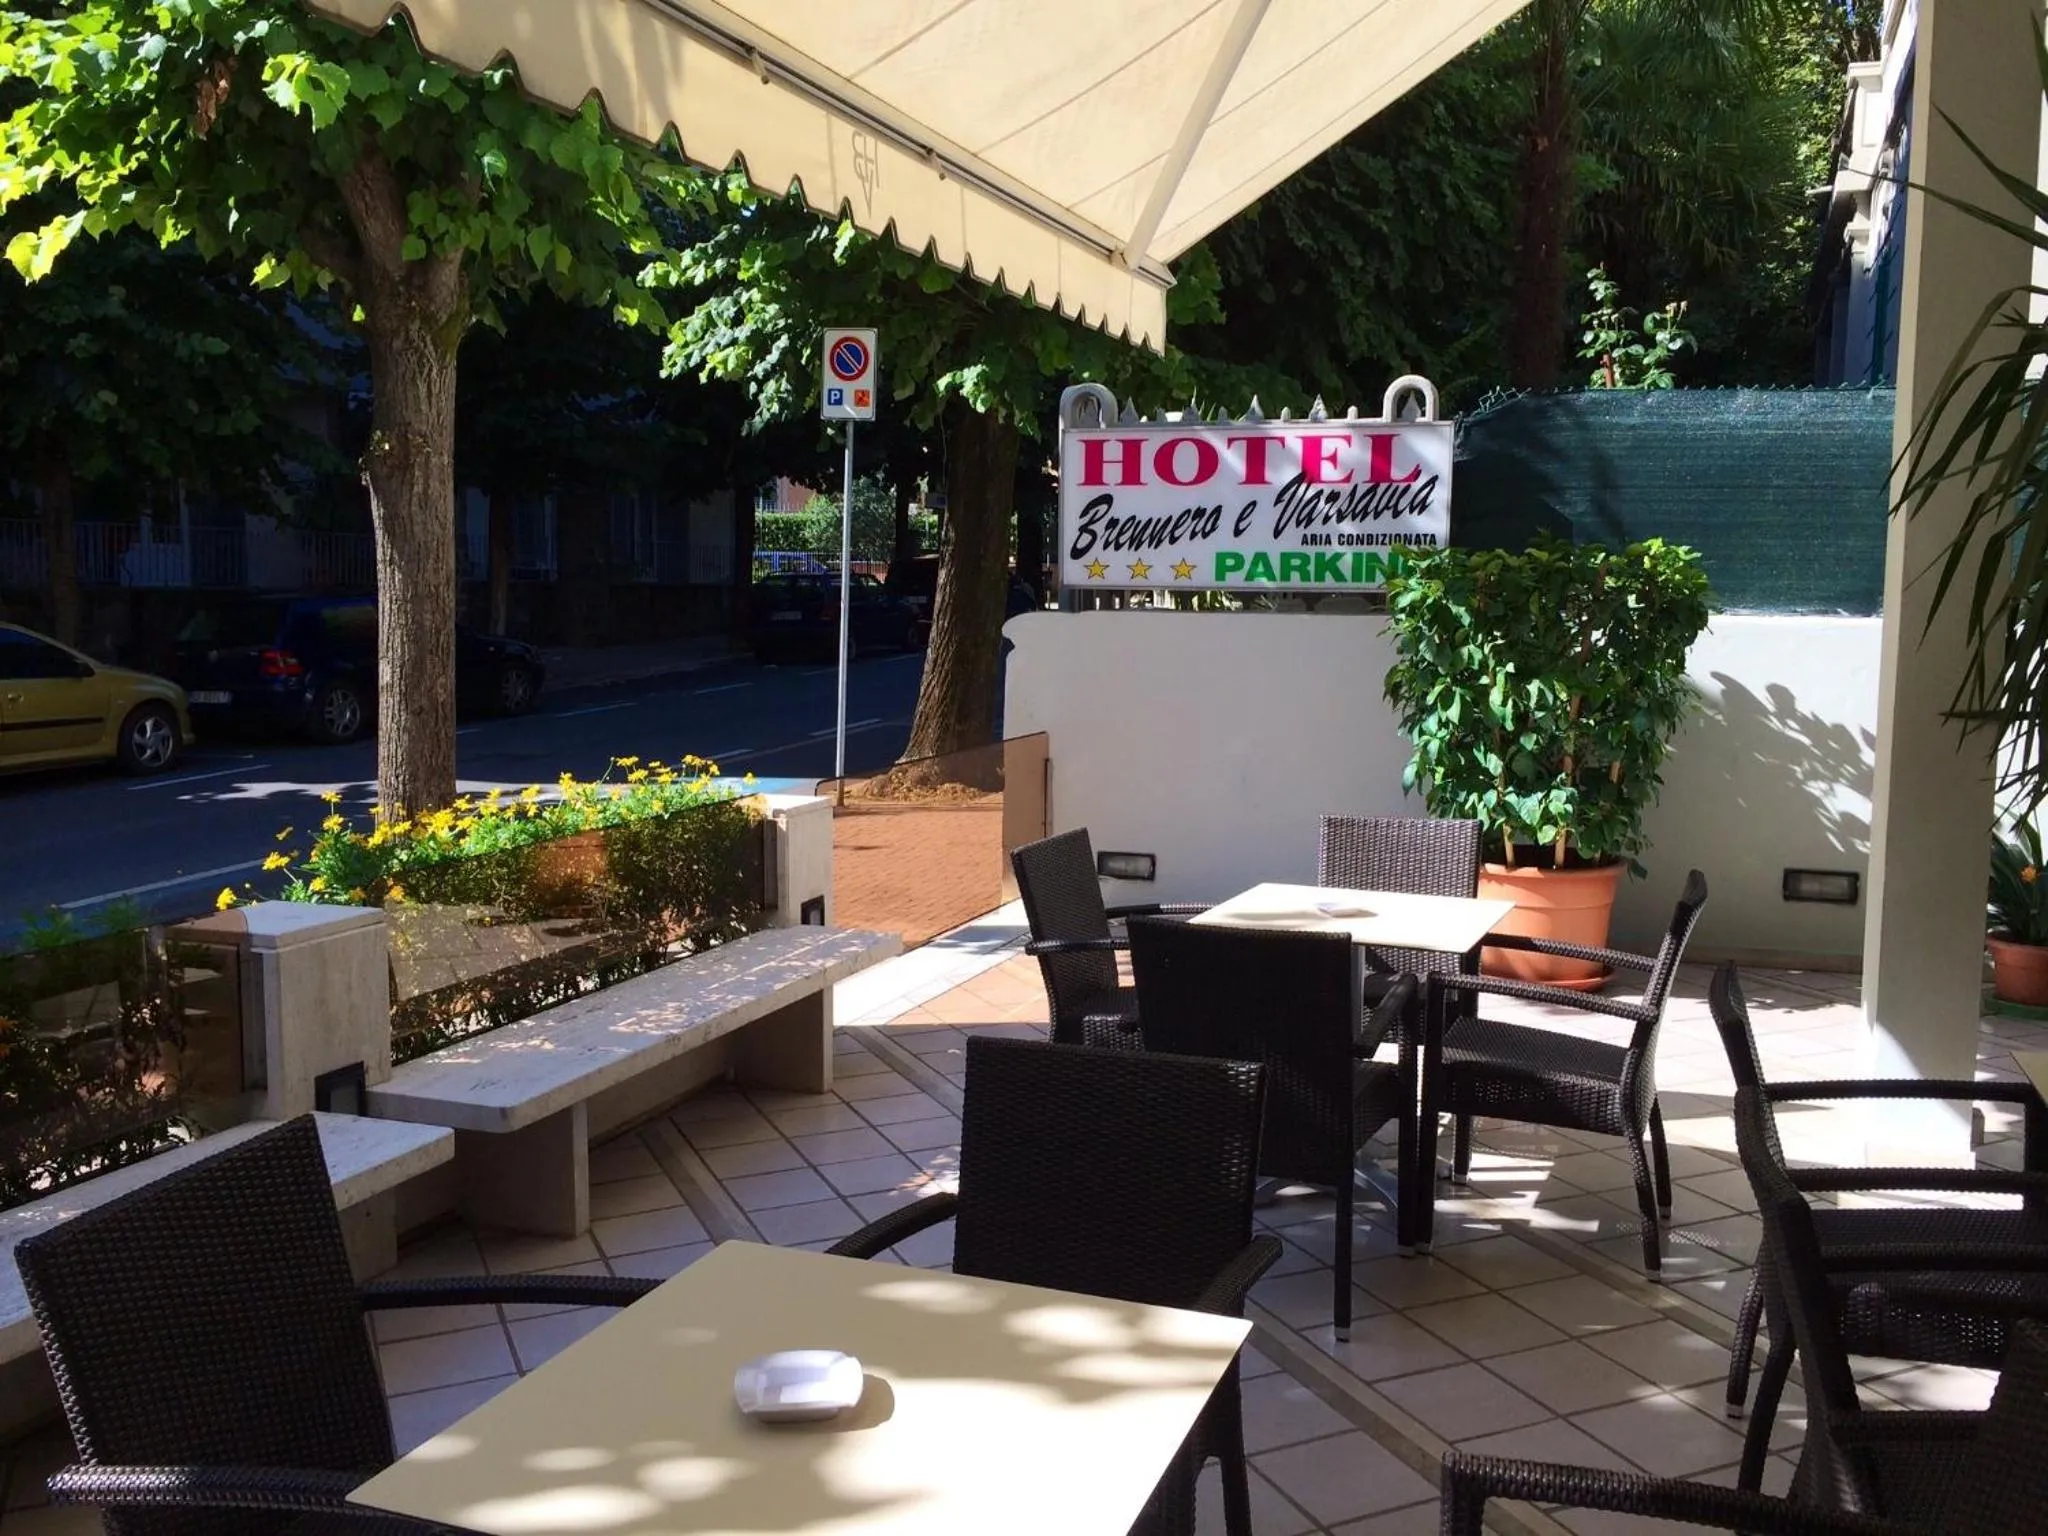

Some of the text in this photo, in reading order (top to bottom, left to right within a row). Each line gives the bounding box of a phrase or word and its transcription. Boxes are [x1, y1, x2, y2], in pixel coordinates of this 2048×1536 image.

[1077, 433, 1422, 487] HOTEL
[1069, 470, 1440, 560] Brennero e Varsavia
[1301, 532, 1438, 547] ARIA CONDIZIONATA
[1214, 551, 1412, 584] PARKIN
